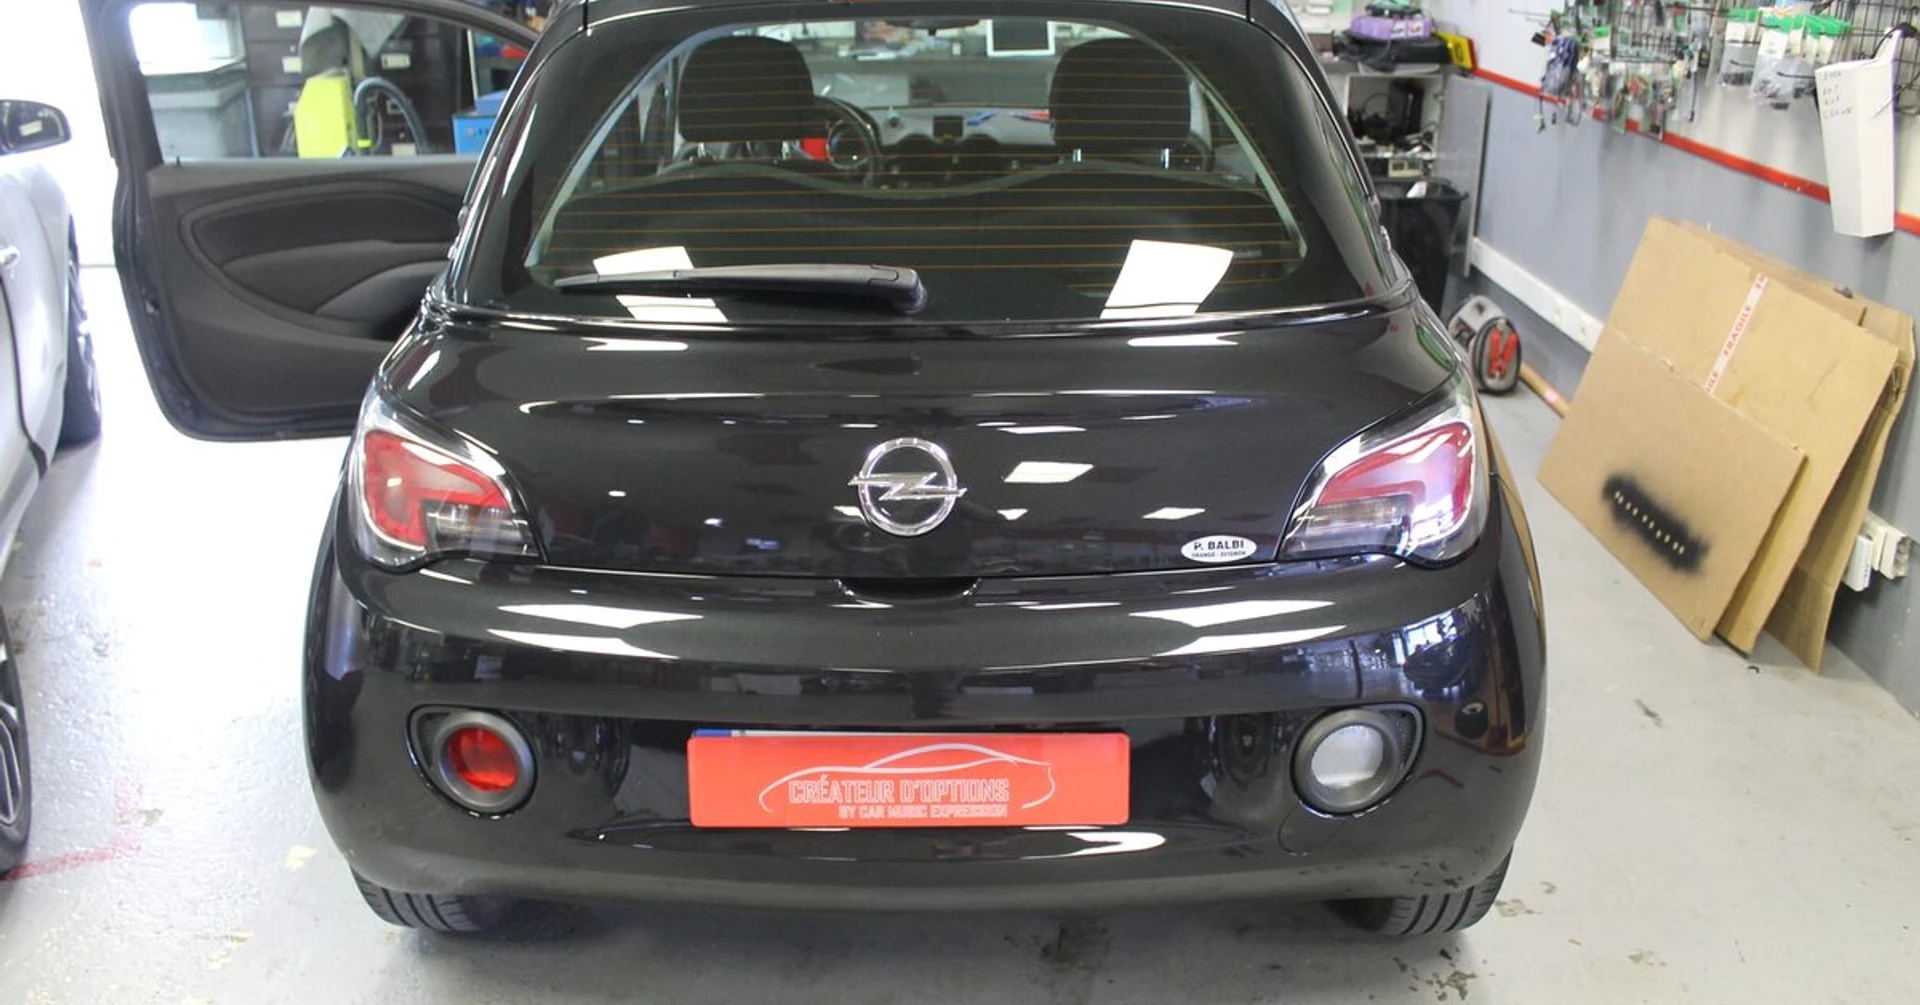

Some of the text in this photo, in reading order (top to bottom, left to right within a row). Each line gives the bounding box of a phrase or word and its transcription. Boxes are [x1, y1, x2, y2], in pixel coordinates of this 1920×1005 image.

[1723, 305, 1751, 357] FRAGILE
[788, 773, 1010, 804] CRÉATEUR D'OPTIONS
[838, 804, 857, 819] BY
[858, 804, 885, 819] CAR
